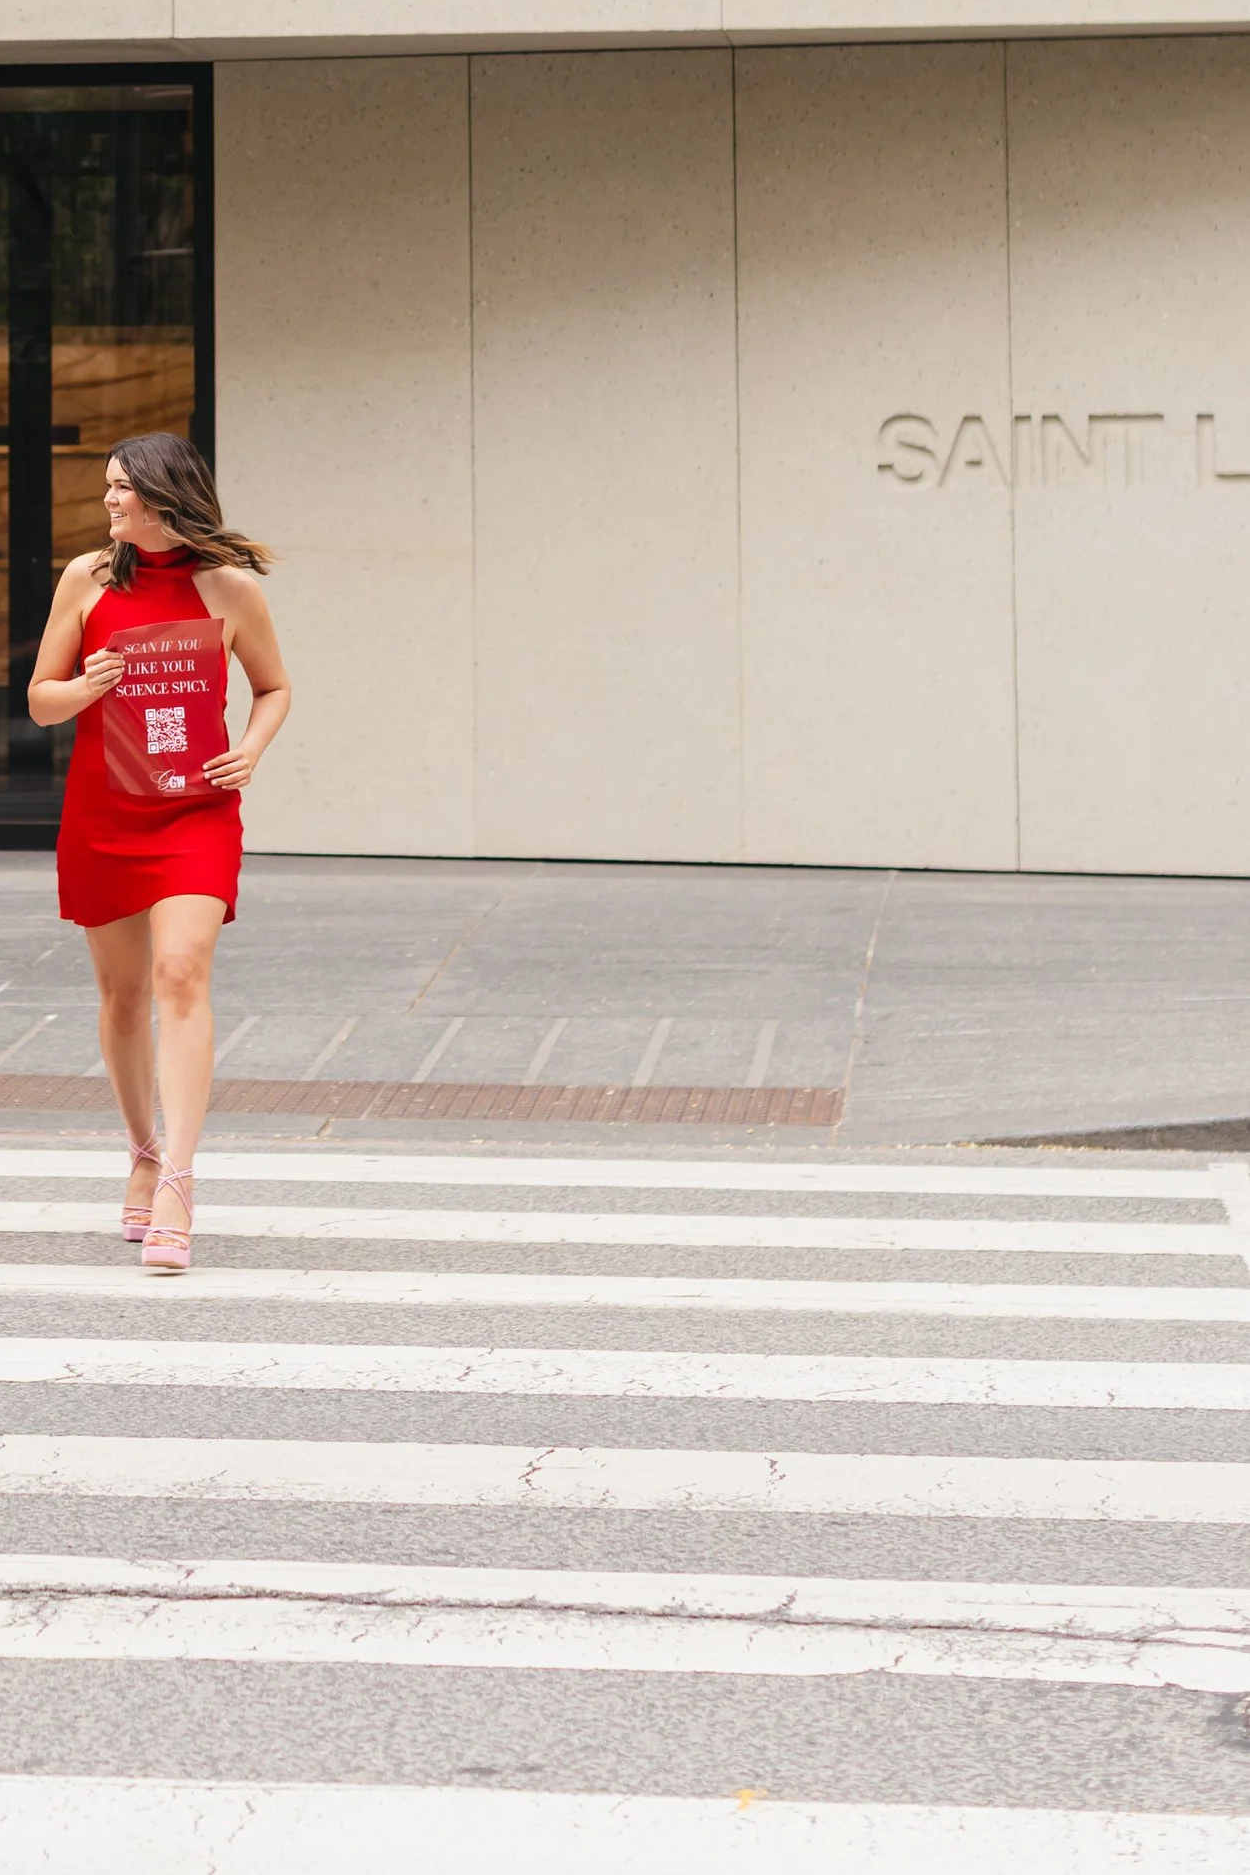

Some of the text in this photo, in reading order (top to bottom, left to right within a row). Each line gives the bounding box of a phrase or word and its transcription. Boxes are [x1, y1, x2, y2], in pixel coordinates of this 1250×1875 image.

[877, 413, 1165, 487] SAINT
[123, 639, 203, 655] SCAN IF YOU
[127, 660, 195, 675] LIKE YOUR
[116, 679, 210, 697] SCIENCE SPICY.
